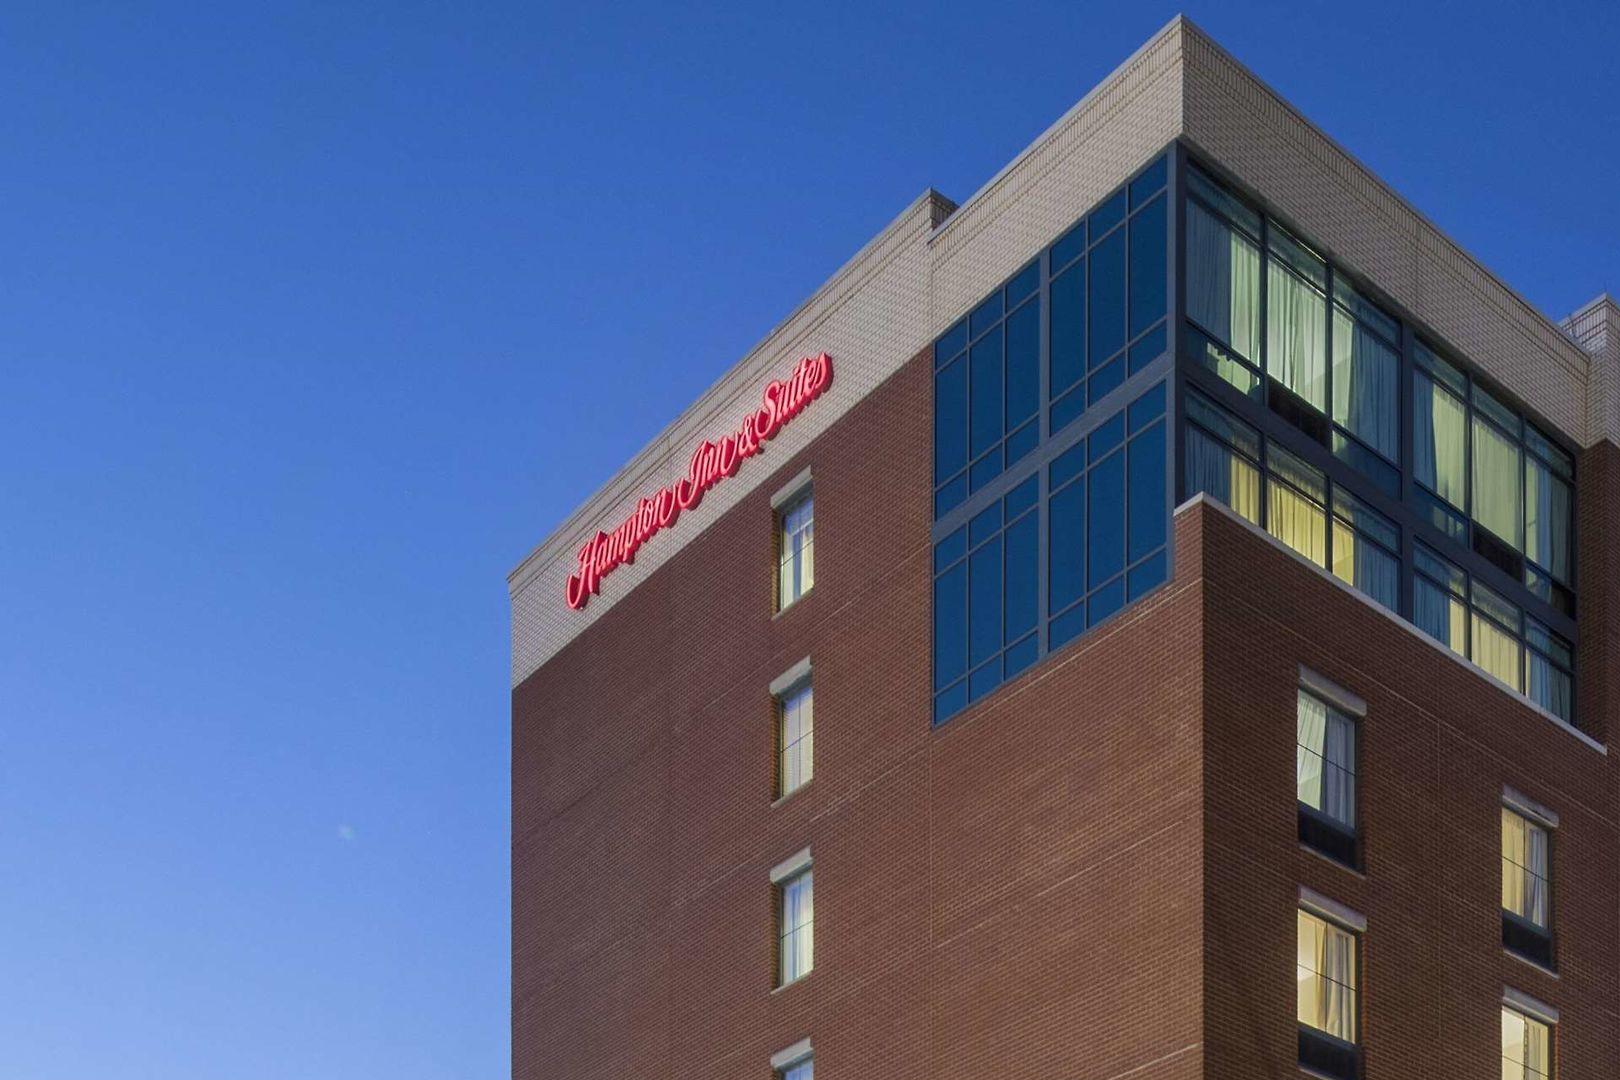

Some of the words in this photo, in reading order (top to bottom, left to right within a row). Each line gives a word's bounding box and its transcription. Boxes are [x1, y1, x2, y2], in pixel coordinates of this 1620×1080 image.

[566, 485, 680, 609] Hampton
[677, 433, 741, 511] Inn
[738, 414, 763, 458] &
[754, 352, 834, 440] Suites
